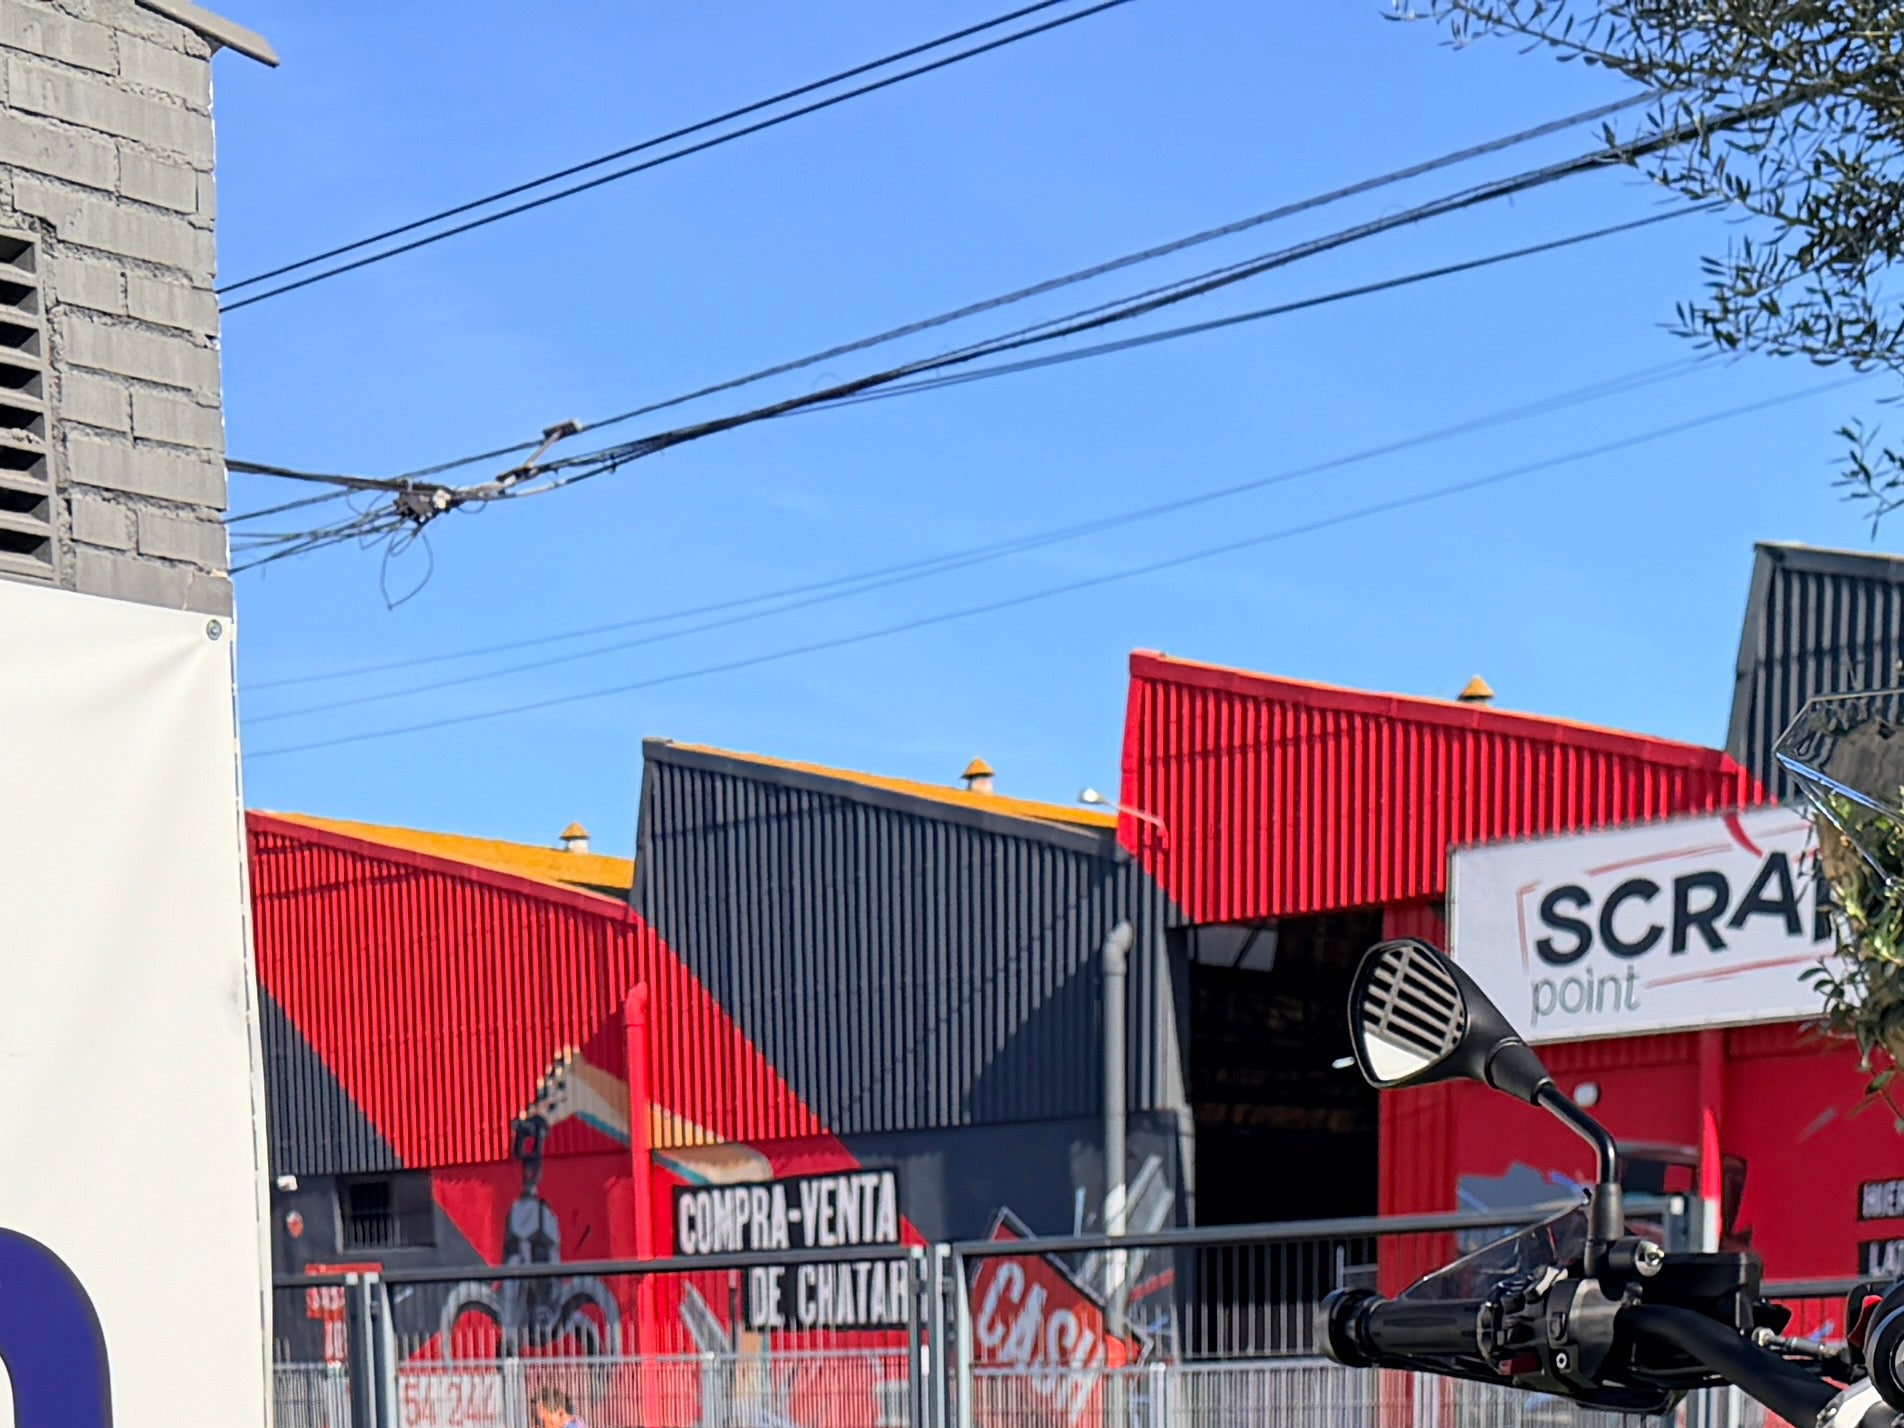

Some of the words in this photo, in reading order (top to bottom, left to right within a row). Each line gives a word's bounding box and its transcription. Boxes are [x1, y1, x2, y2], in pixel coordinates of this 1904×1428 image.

[1530, 965, 1641, 1027] point
[678, 1171, 898, 1255] COMPRA-VENTA
[749, 1263, 784, 1326] DE
[977, 1262, 1101, 1424] CASH
